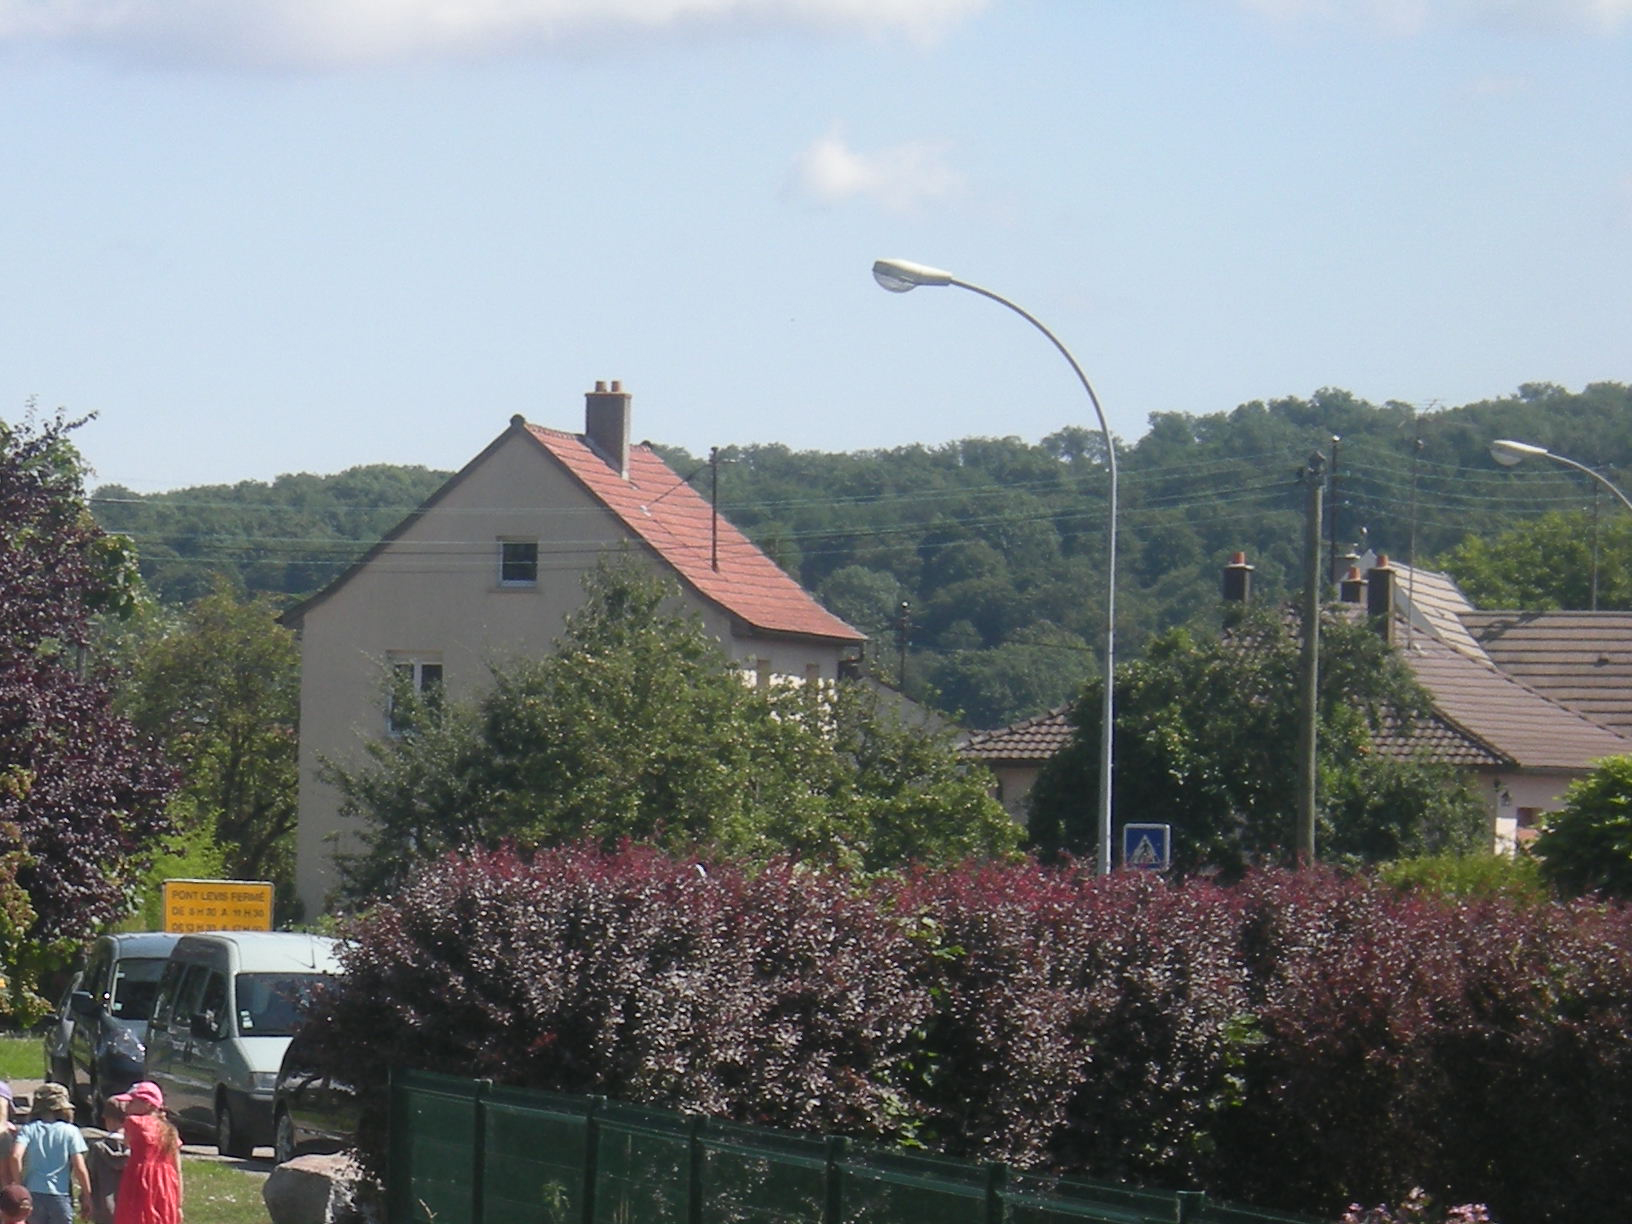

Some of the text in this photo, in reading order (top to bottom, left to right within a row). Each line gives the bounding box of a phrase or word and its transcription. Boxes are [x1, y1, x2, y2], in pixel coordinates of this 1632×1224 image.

[171, 890, 264, 902] PONT LEVIS FERMÉ
[171, 906, 184, 916] DE
